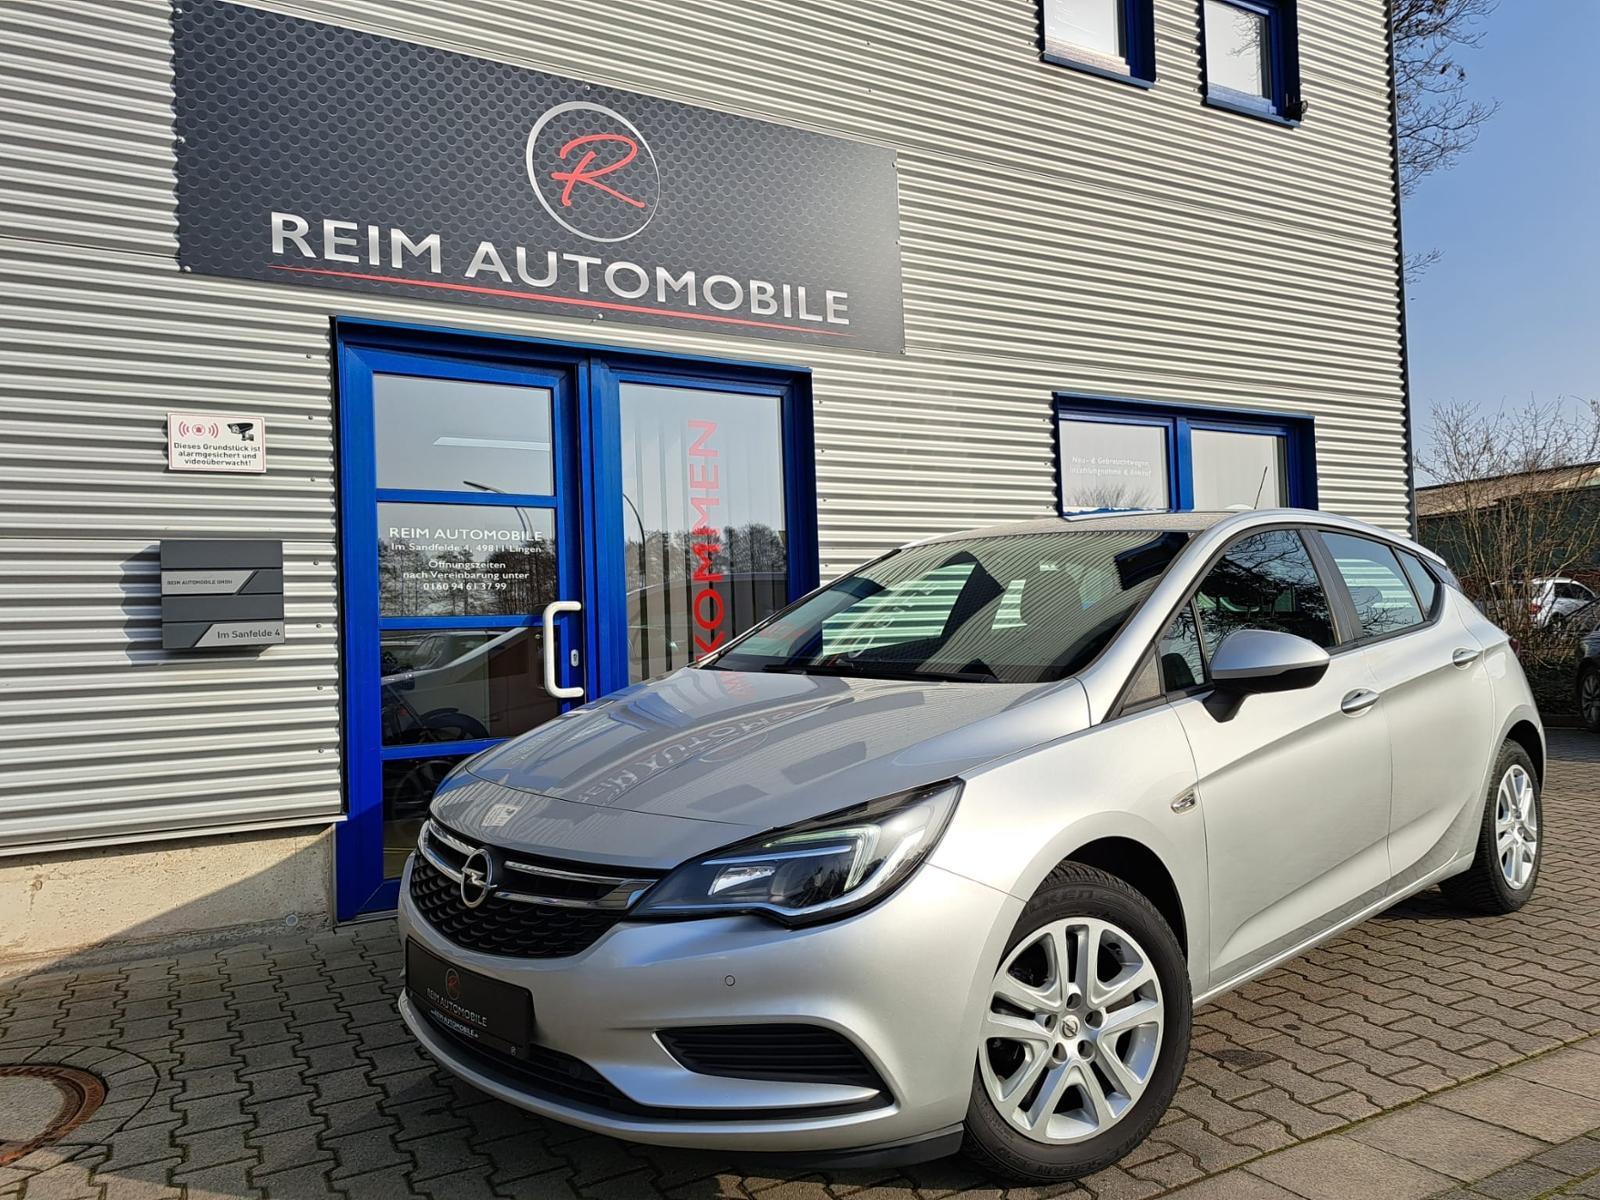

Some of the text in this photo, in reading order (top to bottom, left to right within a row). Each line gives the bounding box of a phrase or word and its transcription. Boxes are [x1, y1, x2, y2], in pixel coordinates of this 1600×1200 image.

[551, 133, 646, 208] R
[270, 211, 850, 325] REIM AUTOMOBILE
[173, 442, 201, 450] Dieses
[202, 443, 249, 451] Grundstück
[178, 450, 241, 459] alarmgesichert
[184, 458, 252, 466] videoüberwacht!
[389, 527, 543, 541] REIM AUTOMOBILE
[391, 543, 405, 551] Im
[408, 542, 460, 552] Sandfelde
[476, 544, 506, 552] 49811
[509, 544, 542, 555] Lingen
[403, 571, 428, 579] nach
[430, 571, 500, 581] Vereinbarung
[423, 582, 449, 591] 0160
[451, 582, 465, 591] 94
[478, 583, 492, 591] 37
[494, 582, 507, 591] 99
[217, 628, 281, 639] Im Sanfelde 4
[440, 997, 488, 1028] AUTOMOBILE
